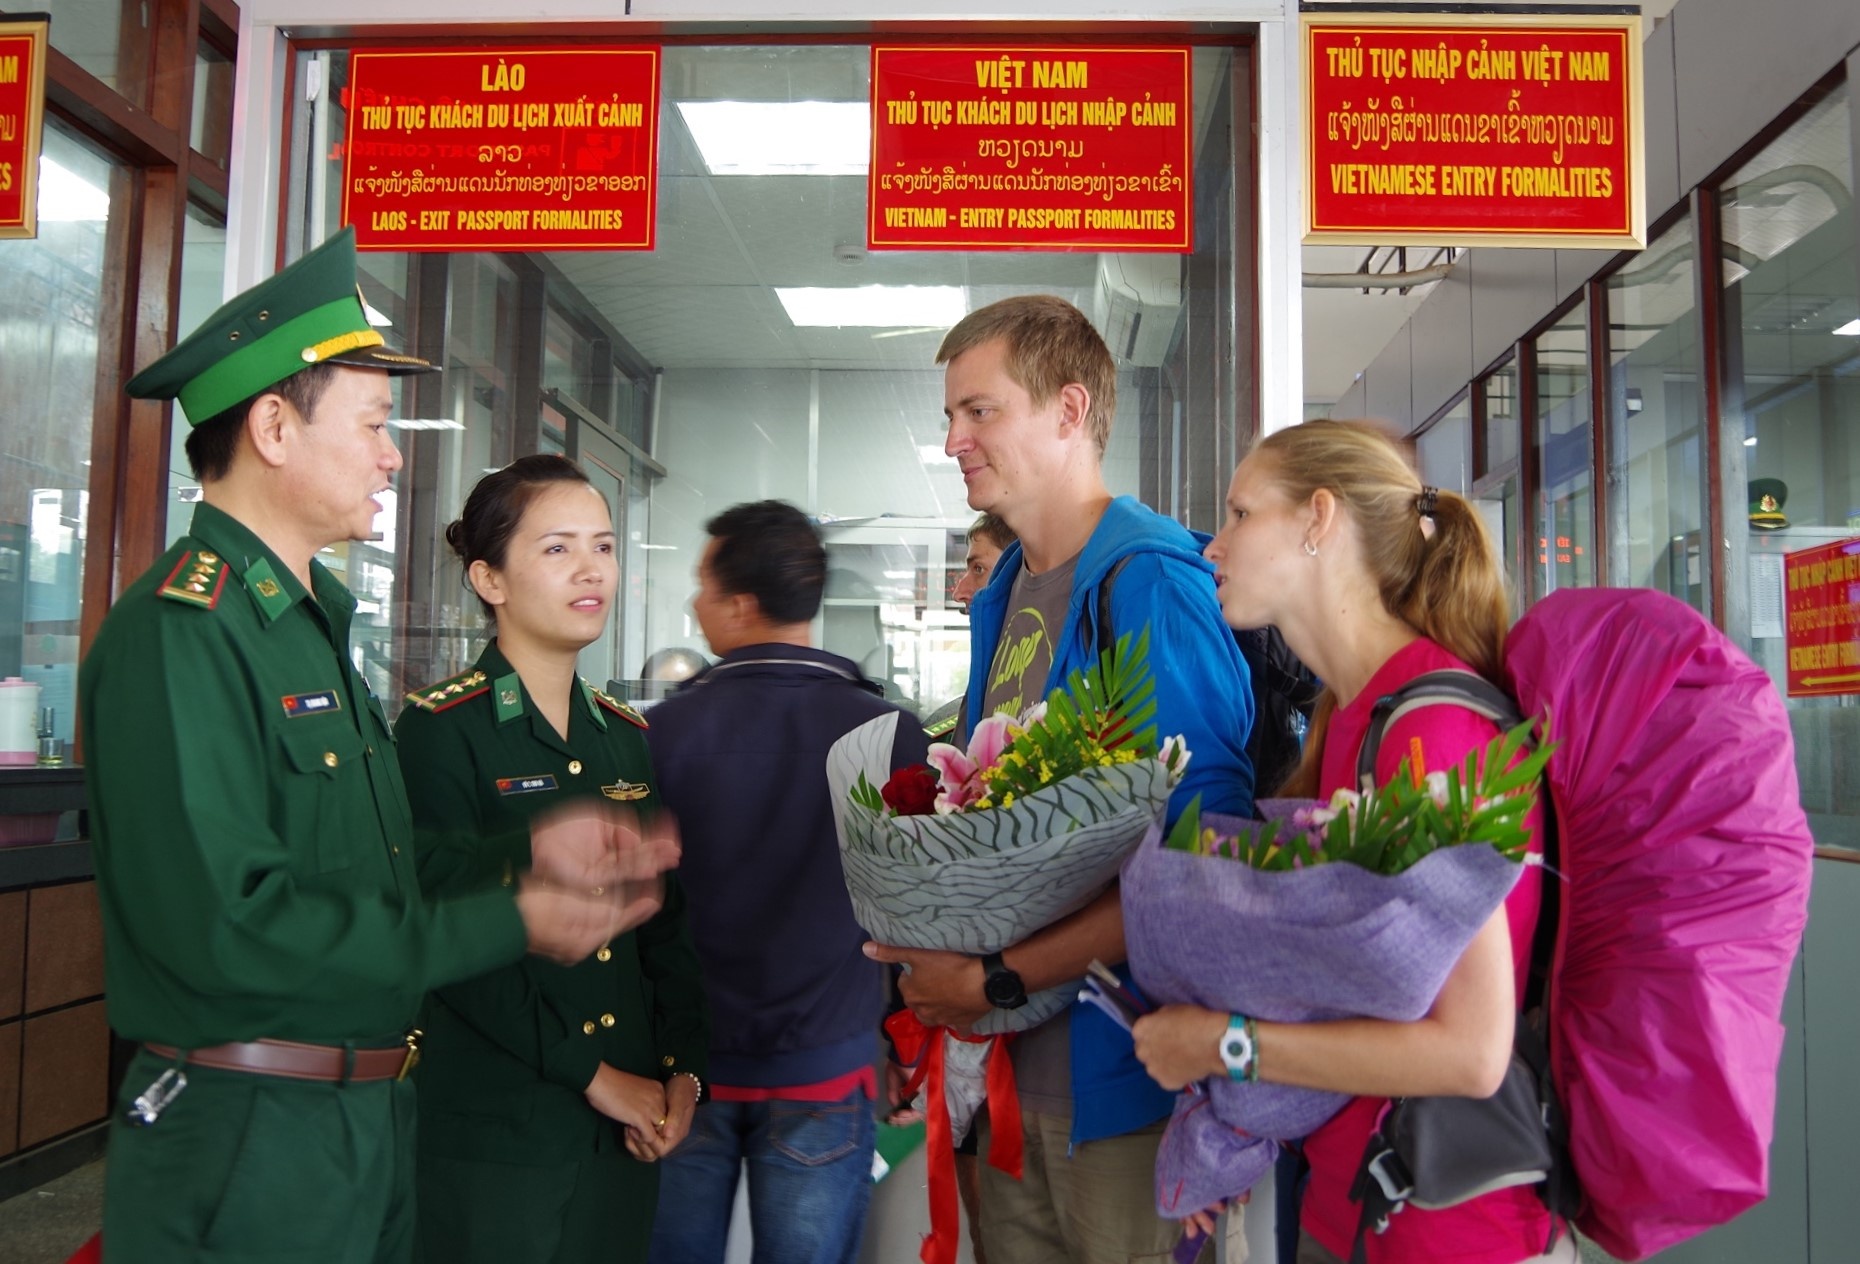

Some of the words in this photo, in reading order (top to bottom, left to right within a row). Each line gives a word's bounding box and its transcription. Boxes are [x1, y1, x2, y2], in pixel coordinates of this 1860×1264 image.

[481, 59, 525, 91] LÀO
[975, 55, 1025, 94] VIỆT
[1033, 61, 1088, 88] NAM
[1326, 36, 1363, 77] THỦ
[1369, 48, 1406, 84] TỤC
[1412, 42, 1461, 84] NHẬP
[1467, 39, 1515, 80] CẢNH
[1521, 44, 1563, 87] VIỆT
[1569, 52, 1610, 81] NAM
[362, 96, 391, 129] THỦ
[396, 106, 425, 134] TỤC
[430, 100, 483, 128] KHÁCH
[488, 105, 509, 127] DU
[513, 104, 549, 131] LỊCH
[553, 95, 594, 127] XUẤT
[598, 93, 642, 127] CẢNH
[887, 90, 917, 125] THỦ
[922, 101, 952, 129] TỤC
[957, 96, 1011, 125] KHÁCH
[1016, 102, 1036, 125] DU
[1042, 102, 1078, 129] LỊCH
[1083, 97, 1126, 131] NHẬP
[1131, 92, 1176, 126] CẢNH
[478, 145, 522, 162] ລາວ
[978, 139, 1084, 168] ຫວຽດນາມ
[1331, 164, 1436, 195] VIETNAMESE
[1442, 166, 1497, 196] ENTRY
[1502, 167, 1613, 198] FORMALITIES
[372, 211, 407, 231] LAOS
[420, 211, 450, 230] EXIT
[457, 210, 529, 230] PASSPORT
[533, 209, 622, 230] FORMALITIES
[885, 207, 947, 228] VIETNAM
[960, 208, 1004, 228] ENTRY
[1008, 209, 1081, 229] PASSPORT
[1085, 209, 1175, 230] FORMALITIES
